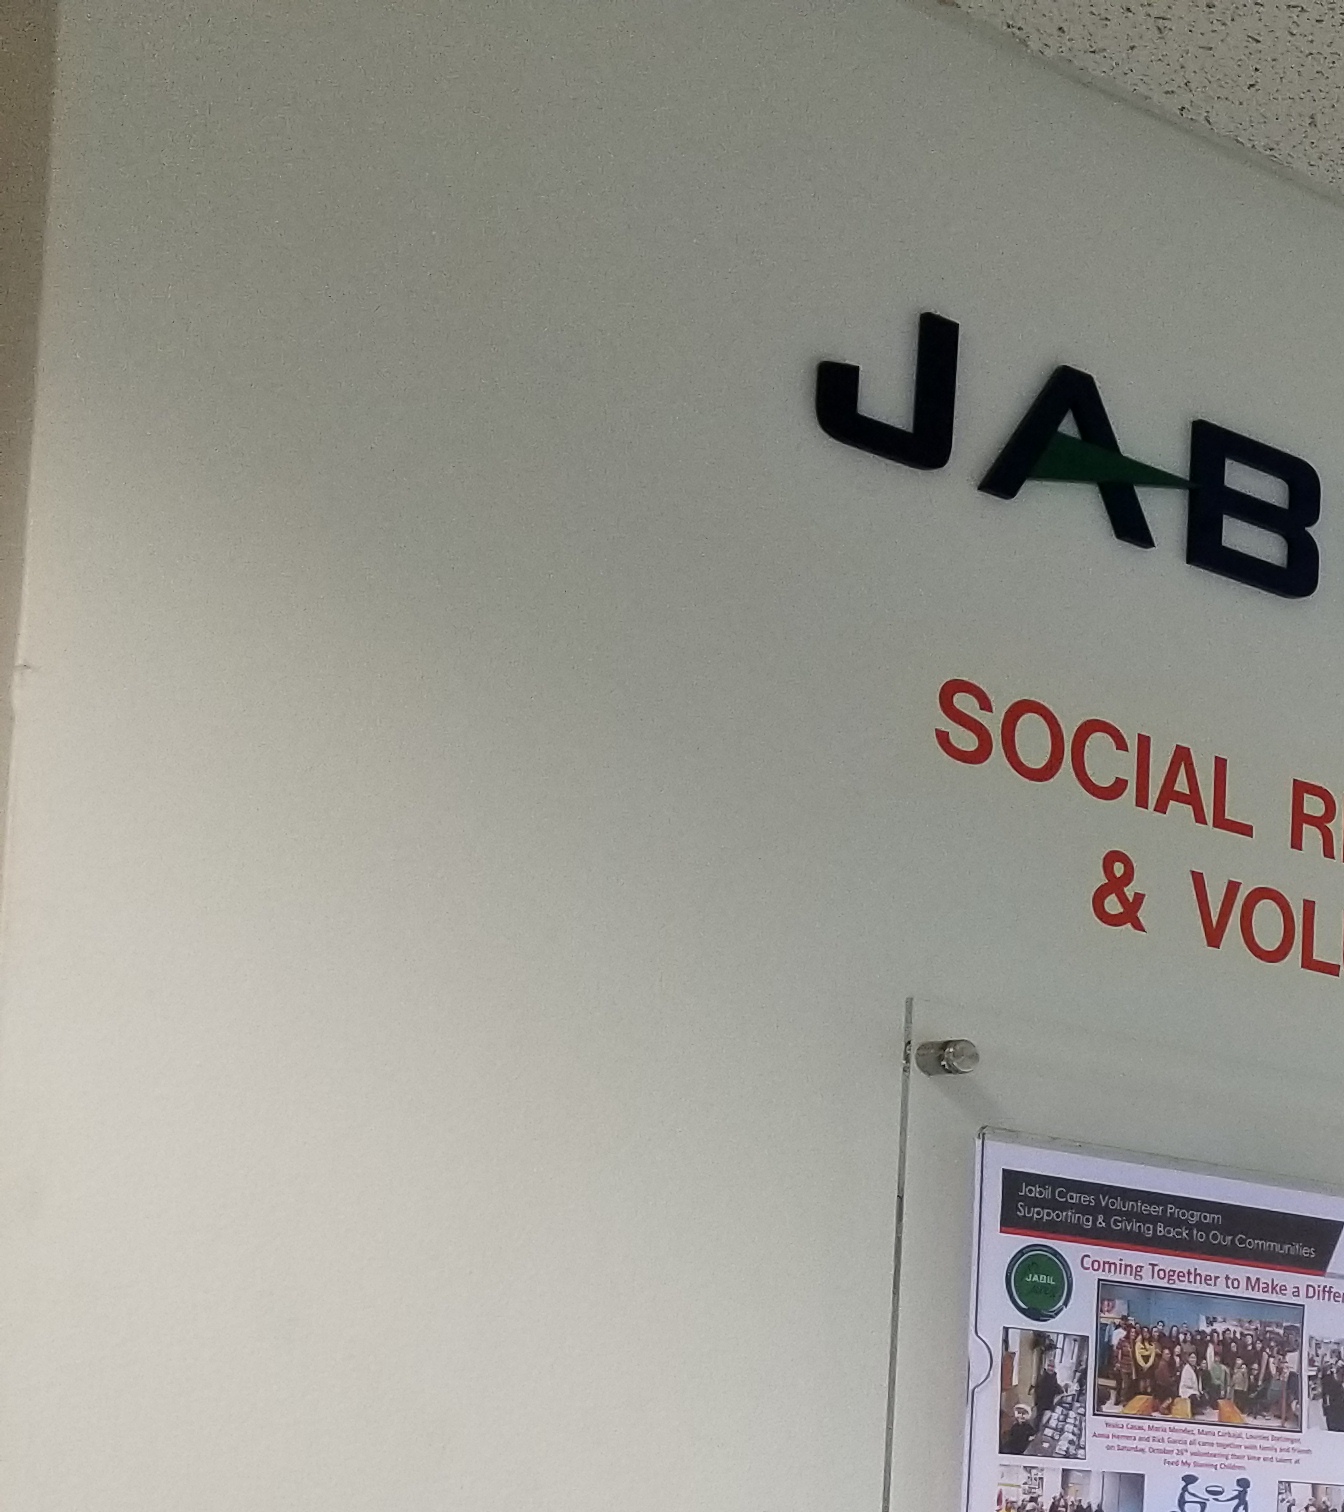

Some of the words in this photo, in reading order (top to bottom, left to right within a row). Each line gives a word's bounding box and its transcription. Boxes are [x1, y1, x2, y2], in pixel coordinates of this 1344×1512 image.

[934, 677, 1255, 839] SOCIAL
[1092, 850, 1146, 934] &
[1018, 1182, 1052, 1199] Jabil
[1055, 1187, 1095, 1206] Cares
[1099, 1194, 1164, 1216] Volunteer
[1167, 1204, 1222, 1225] Program
[1016, 1201, 1093, 1229] Supporting
[1096, 1214, 1106, 1228] &
[1110, 1216, 1154, 1237] Giving
[1156, 1222, 1189, 1240] Back
[1193, 1228, 1206, 1242] to
[1209, 1230, 1233, 1245] Our
[1235, 1234, 1316, 1258] Communities
[1025, 1273, 1056, 1285] JABIL
[1080, 1254, 1145, 1281] Coming
[1148, 1262, 1221, 1287] Together
[1224, 1274, 1241, 1290] to
[1245, 1275, 1288, 1297] Make
[1291, 1285, 1300, 1298] a
